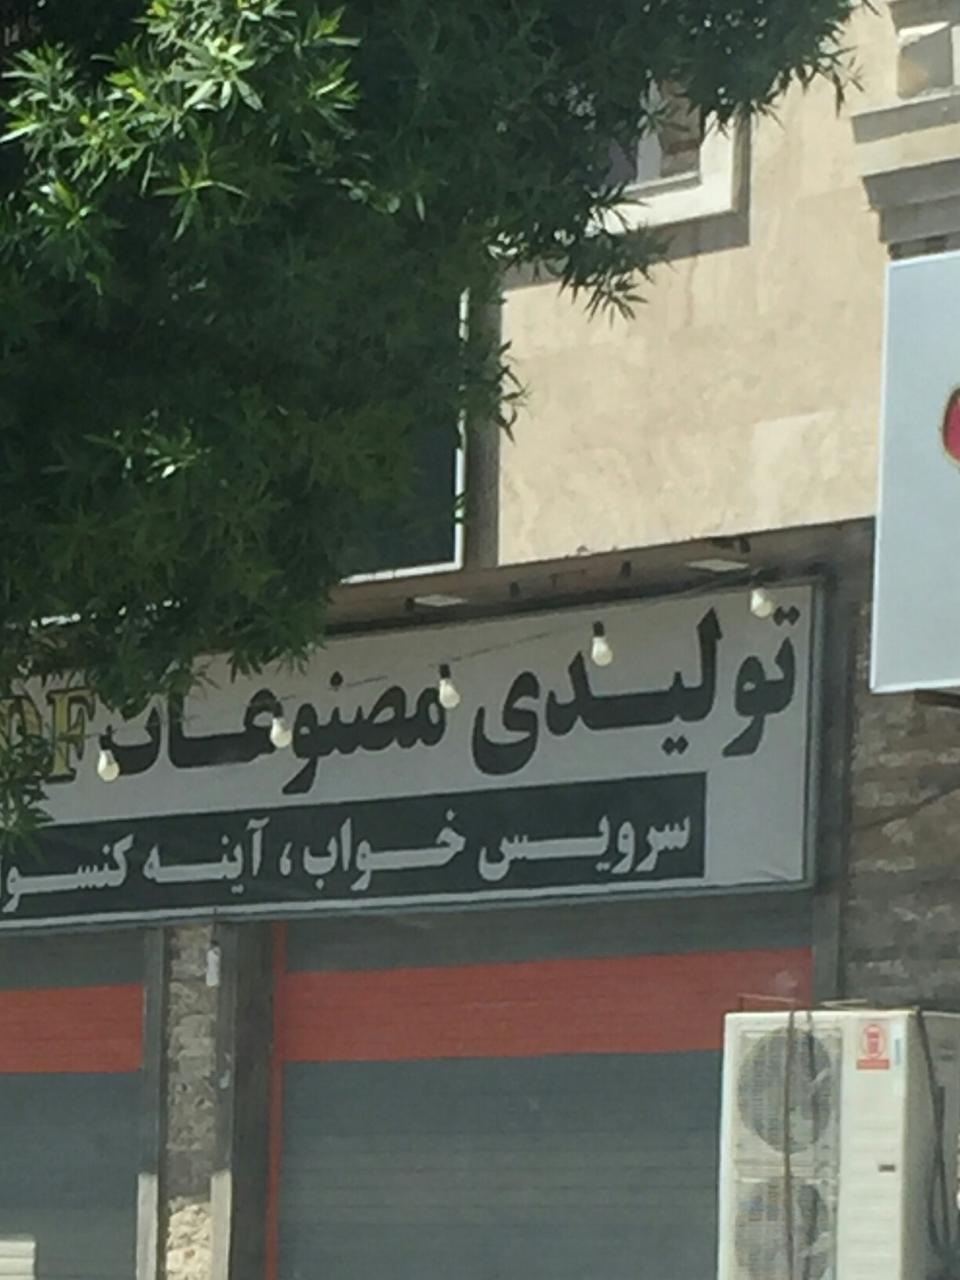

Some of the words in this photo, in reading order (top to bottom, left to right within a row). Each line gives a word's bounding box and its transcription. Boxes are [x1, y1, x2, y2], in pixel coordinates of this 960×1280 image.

[471, 605, 801, 776] تولیدی
[142, 816, 270, 895] آینه
[478, 814, 690, 883] سرویس
